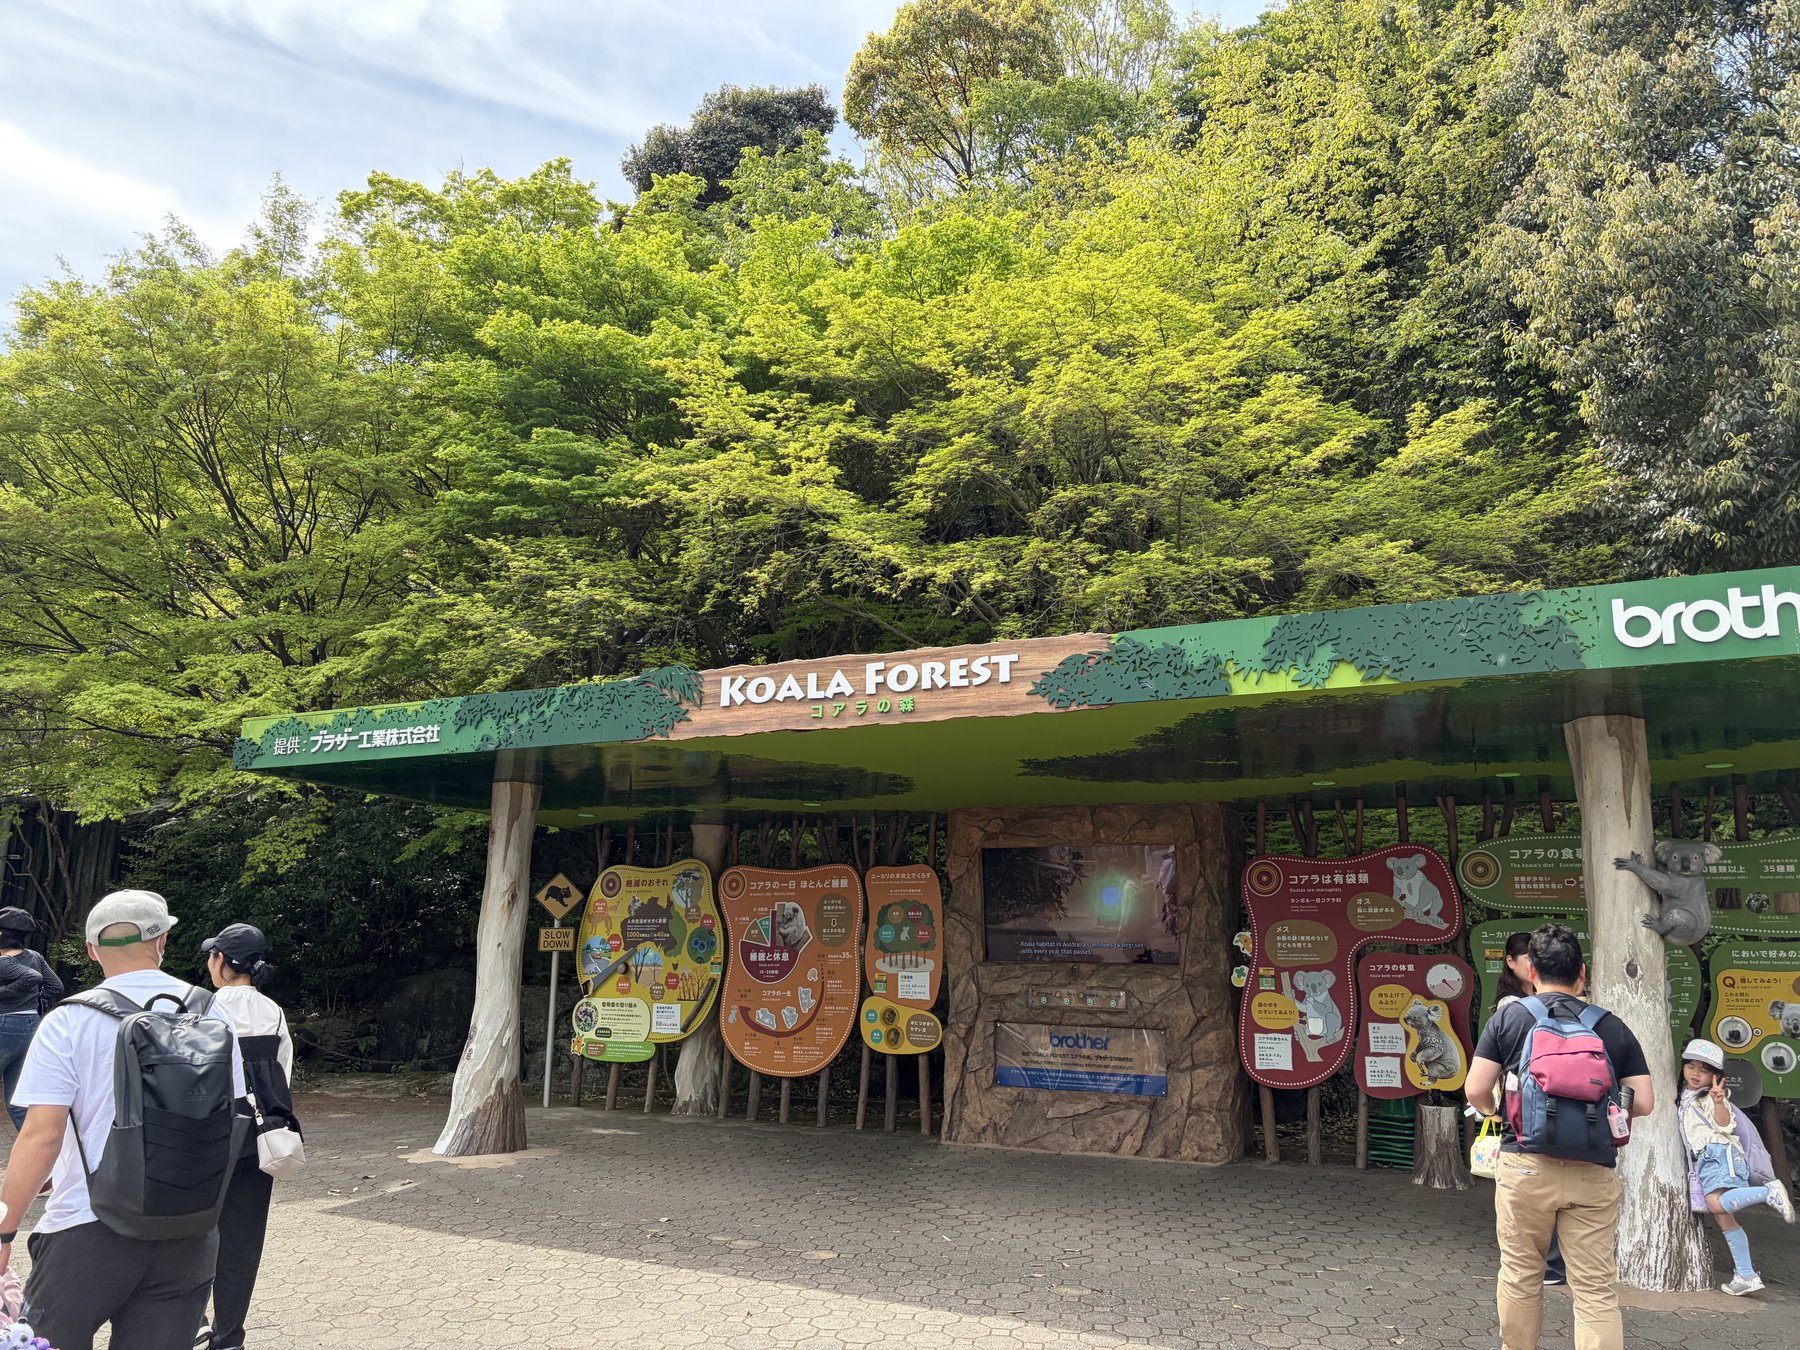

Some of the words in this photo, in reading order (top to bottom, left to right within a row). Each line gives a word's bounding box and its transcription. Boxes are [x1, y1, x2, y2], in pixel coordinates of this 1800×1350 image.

[720, 668, 855, 707] KOALA
[865, 653, 1019, 695] FOREST
[810, 697, 915, 718] コアラの森
[626, 879, 669, 888] 絶滅のおそれ
[1289, 873, 1369, 884] コアラは有袋類
[750, 880, 796, 890] コアラの一日
[800, 879, 848, 888] ほとんど睡眠
[544, 930, 570, 940] SLOW
[543, 940, 570, 949] DOWN
[750, 952, 789, 961] 睡眠と休息
[1050, 1032, 1110, 1050] brother
